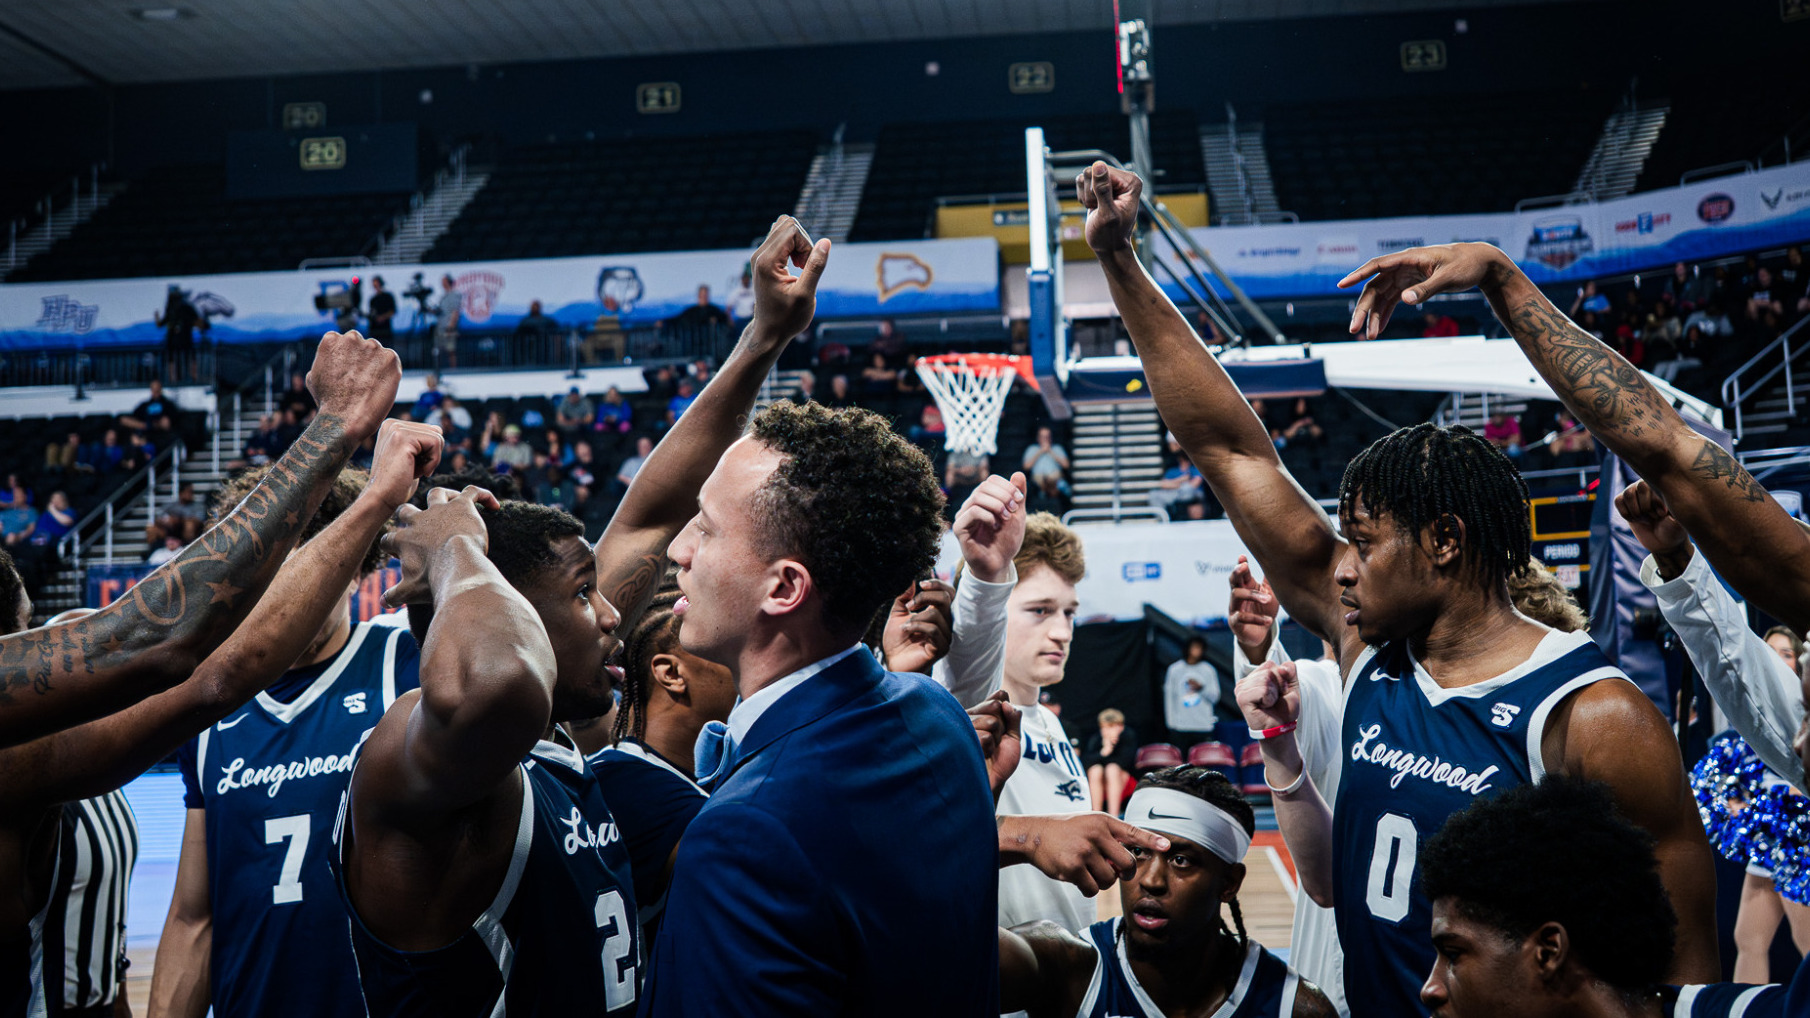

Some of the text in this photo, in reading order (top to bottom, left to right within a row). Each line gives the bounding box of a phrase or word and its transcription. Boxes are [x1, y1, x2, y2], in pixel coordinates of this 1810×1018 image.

[307, 144, 341, 162] 20
[1543, 543, 1580, 560] PERIOD
[216, 741, 360, 799] Longwood
[1351, 723, 1500, 796] Longwood
[264, 813, 311, 905] 7
[1366, 812, 1418, 924] 0
[594, 890, 636, 1013] 2
